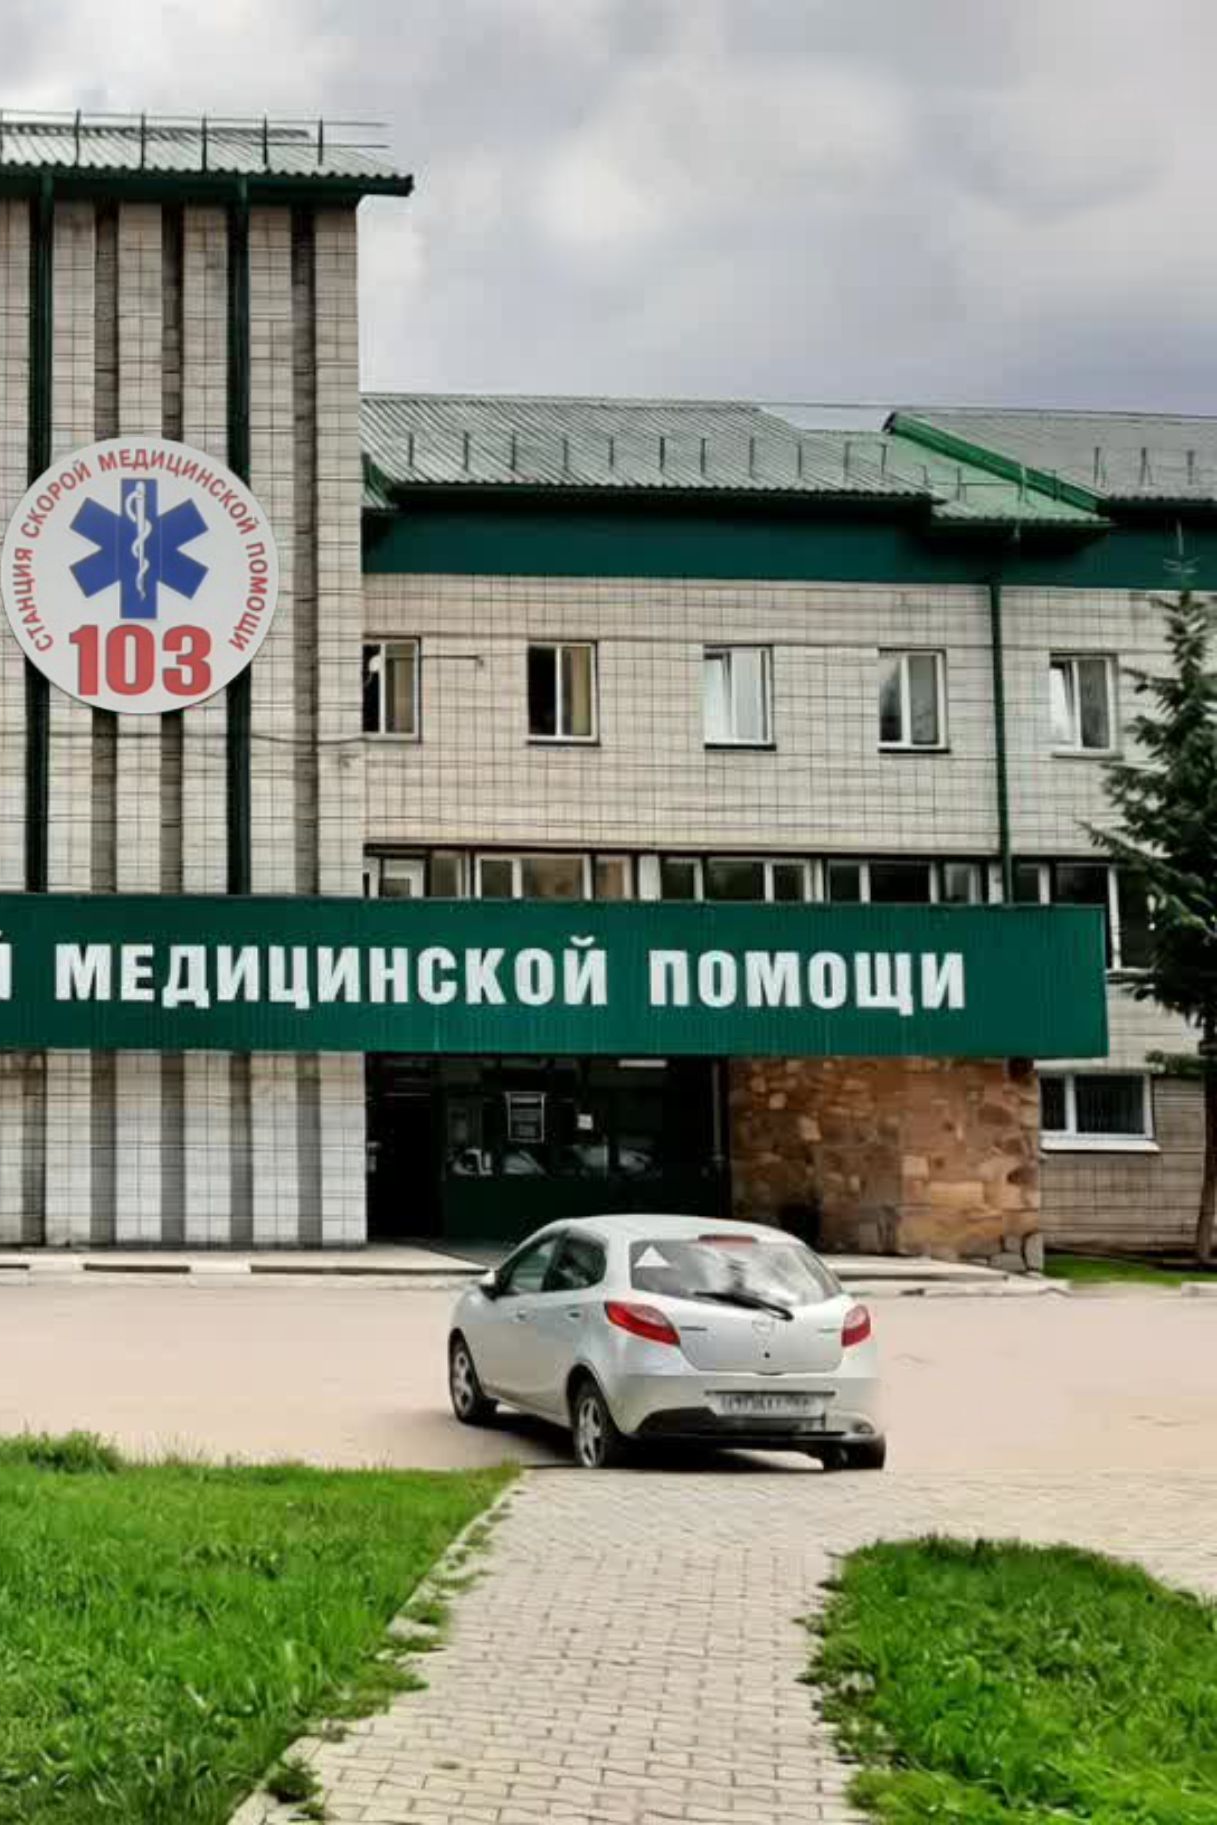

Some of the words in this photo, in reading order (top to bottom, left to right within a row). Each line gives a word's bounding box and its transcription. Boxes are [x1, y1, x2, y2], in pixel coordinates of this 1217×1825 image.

[20, 459, 92, 539] СКОРОЙ
[97, 448, 260, 535] МЕДИЦИНСКОЙ
[13, 547, 54, 653] СТАНЦИЯ
[228, 541, 270, 653] ПОМОЩИ
[68, 623, 213, 697] 103
[55, 936, 608, 1010] МЕДИЦИНСКОЙ
[649, 950, 965, 1016] ПОМОЩИ
